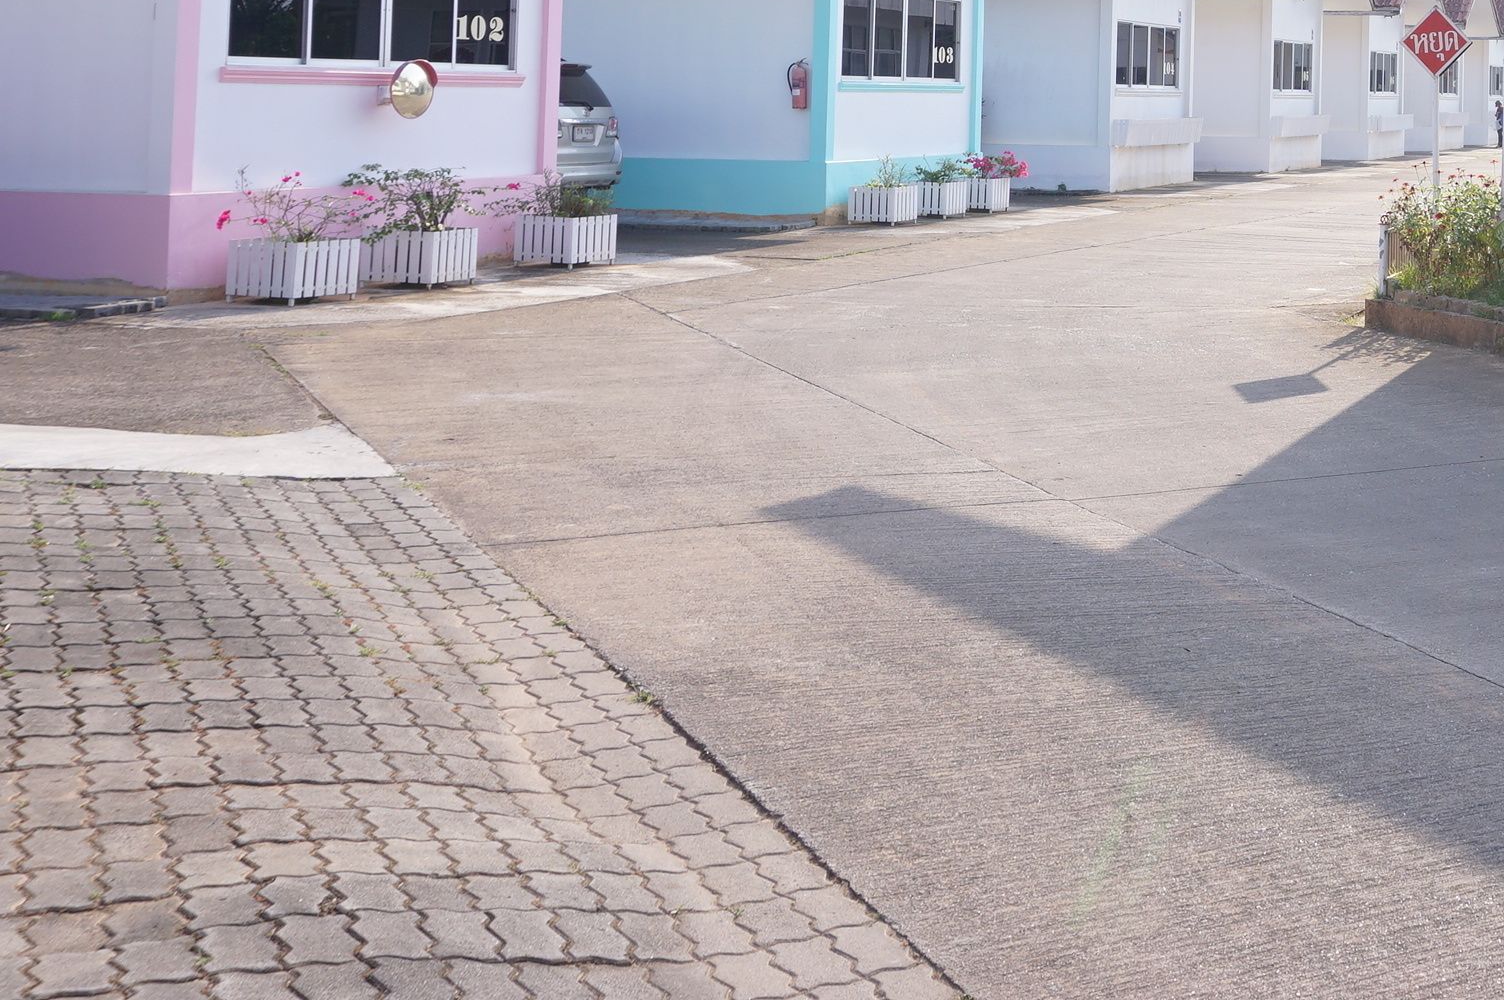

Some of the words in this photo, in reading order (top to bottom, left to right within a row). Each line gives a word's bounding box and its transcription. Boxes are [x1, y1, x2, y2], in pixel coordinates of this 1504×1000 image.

[456, 15, 504, 42] 102
[933, 46, 954, 64] 103
[1410, 30, 1459, 62] หยุด
